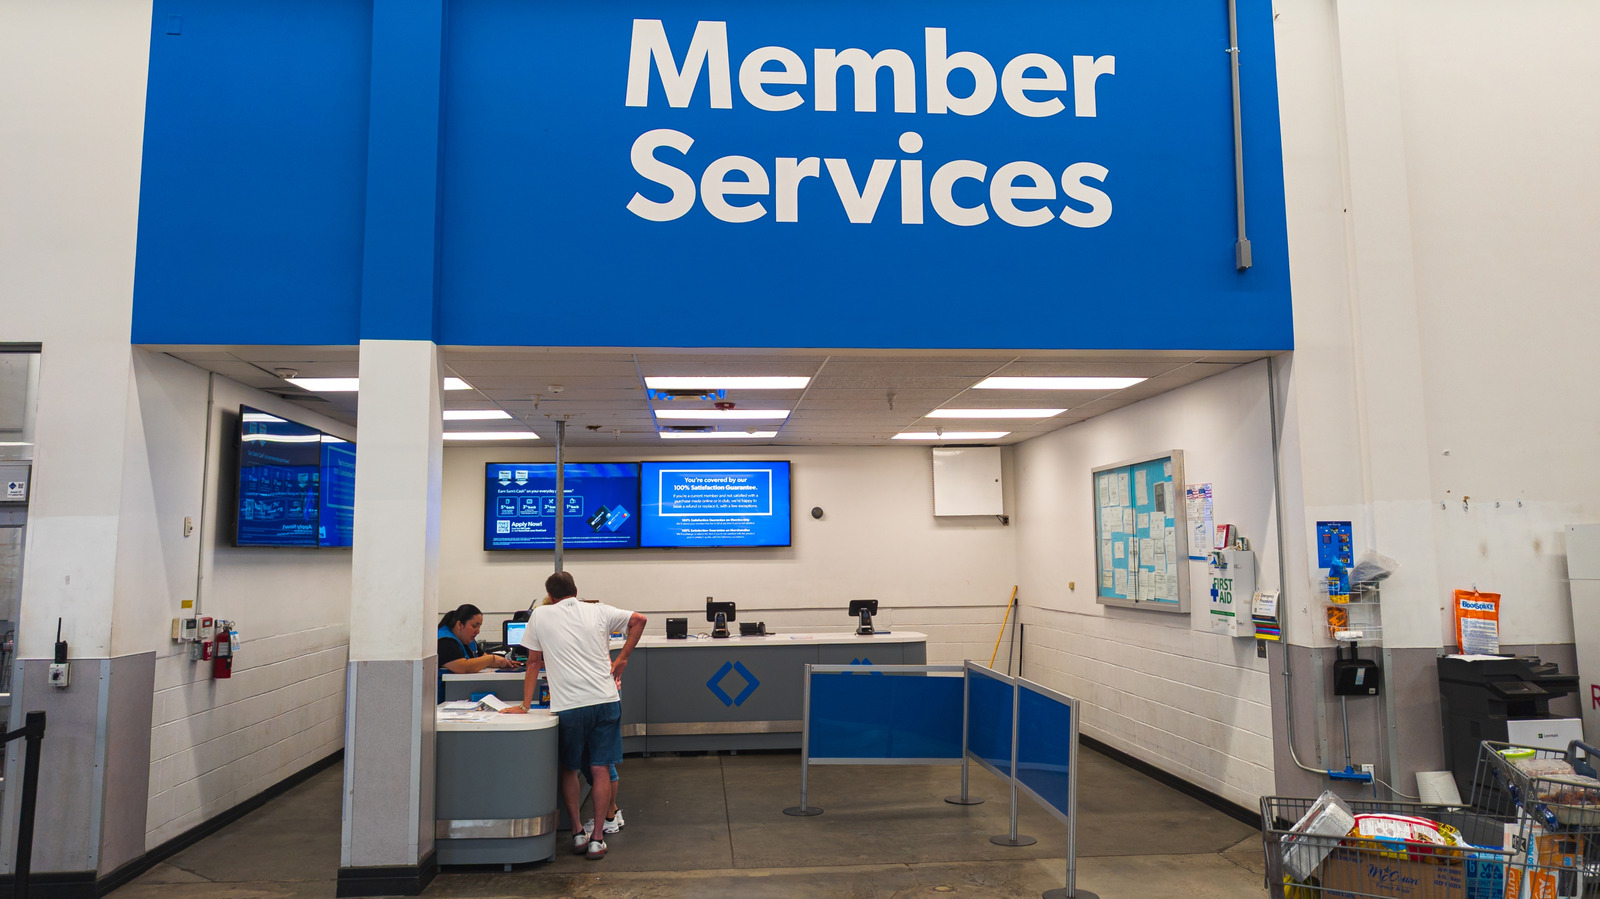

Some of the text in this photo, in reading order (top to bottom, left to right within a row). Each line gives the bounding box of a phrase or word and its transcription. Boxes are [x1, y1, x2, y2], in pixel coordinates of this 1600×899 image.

[625, 18, 1116, 118] Member
[626, 128, 1113, 228] Services
[1213, 577, 1233, 591] FIRST
[1219, 592, 1232, 604] AID
